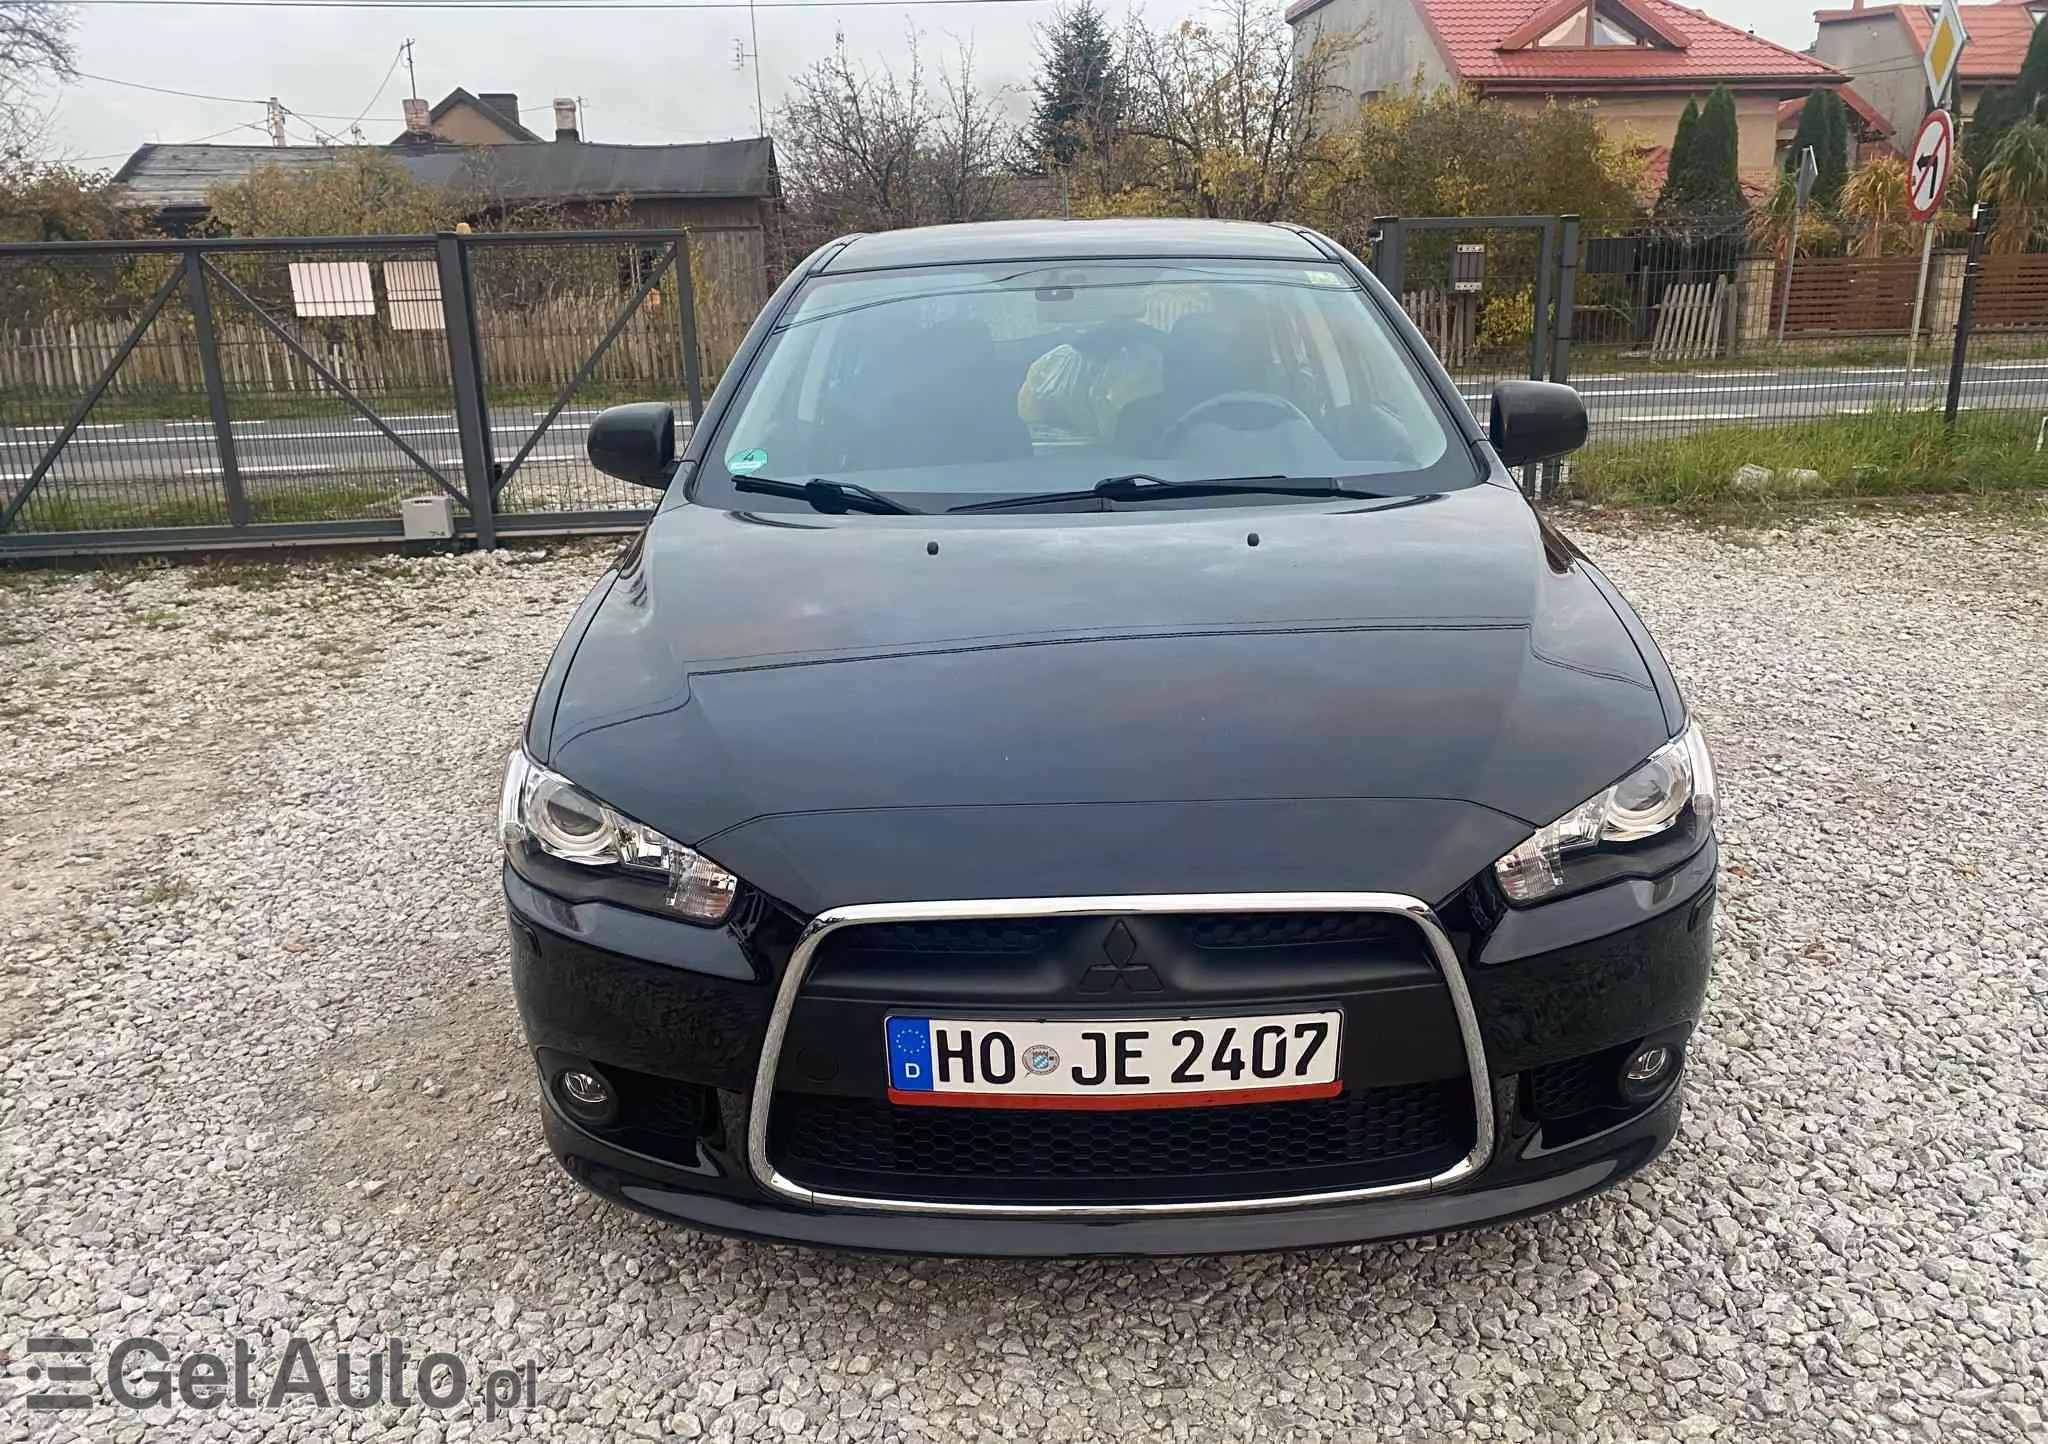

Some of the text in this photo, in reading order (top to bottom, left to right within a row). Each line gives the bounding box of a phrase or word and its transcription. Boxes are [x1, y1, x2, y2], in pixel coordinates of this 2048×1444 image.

[905, 1063, 920, 1078] D
[935, 1021, 1329, 1086] HO JE 2407
